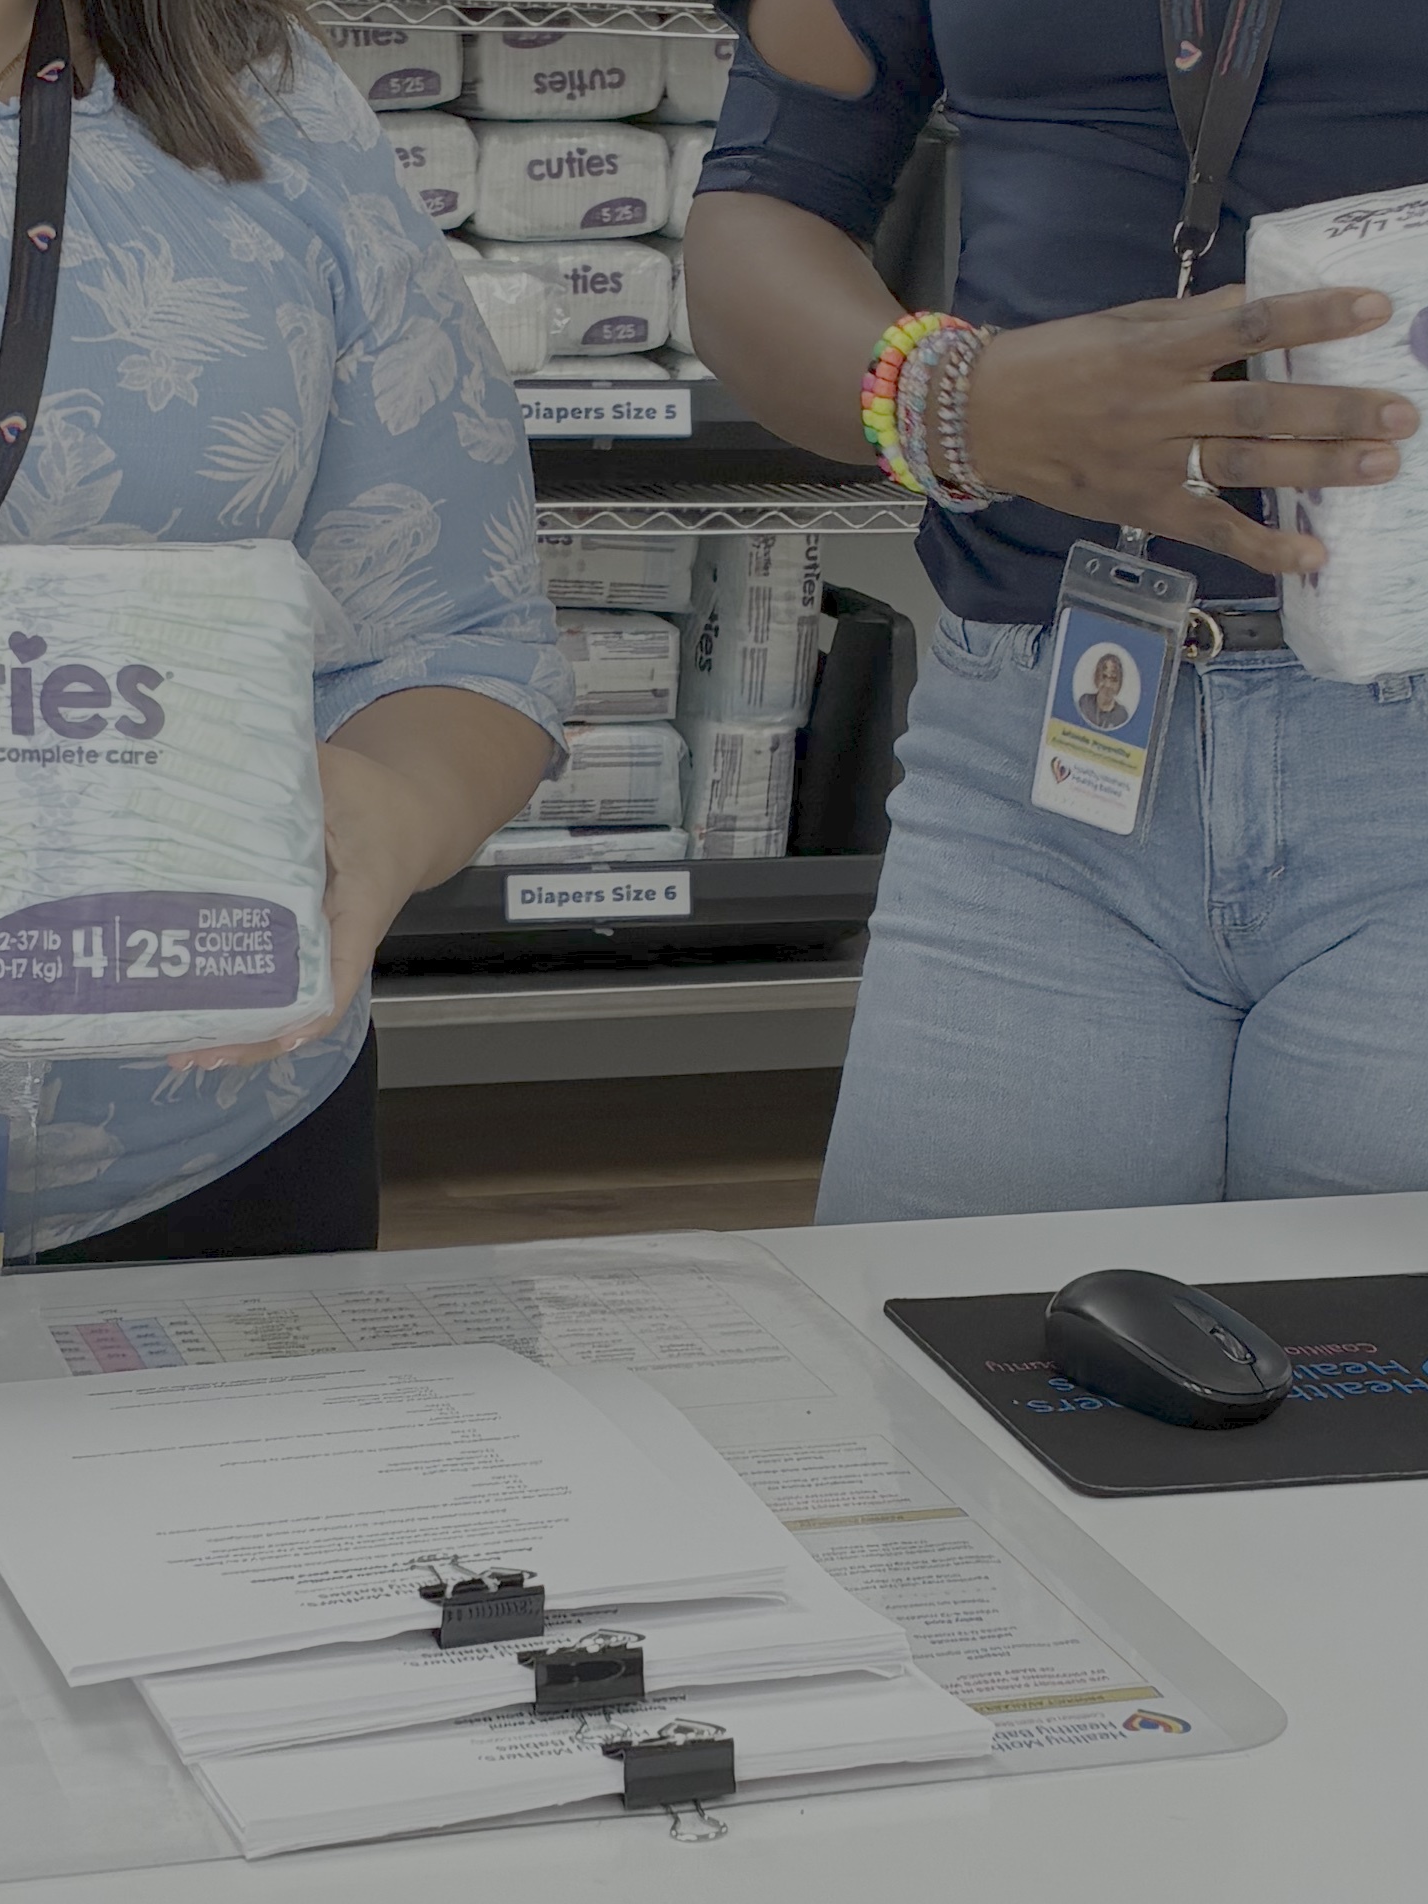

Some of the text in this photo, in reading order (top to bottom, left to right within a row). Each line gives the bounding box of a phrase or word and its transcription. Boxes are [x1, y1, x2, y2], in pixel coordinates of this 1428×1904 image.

[389, 77, 425, 93] 5 25
[534, 68, 626, 101] cuties
[526, 148, 620, 181] cuties
[600, 206, 634, 223] 5 25
[602, 323, 636, 339] 5 25
[612, 403, 656, 421] Size
[664, 404, 677, 420] 5
[106, 745, 160, 766] care
[521, 883, 677, 908] Diapers Size 6
[198, 908, 272, 930] DIAPERS
[42, 929, 62, 952] lb
[194, 930, 274, 954] COUCHES
[71, 926, 192, 980] 4 25
[32, 956, 63, 982] kg)
[194, 953, 276, 978] PAÑALES
[1034, 1720, 1117, 1736] Healthy
[1044, 1730, 1128, 1748] Healthy
